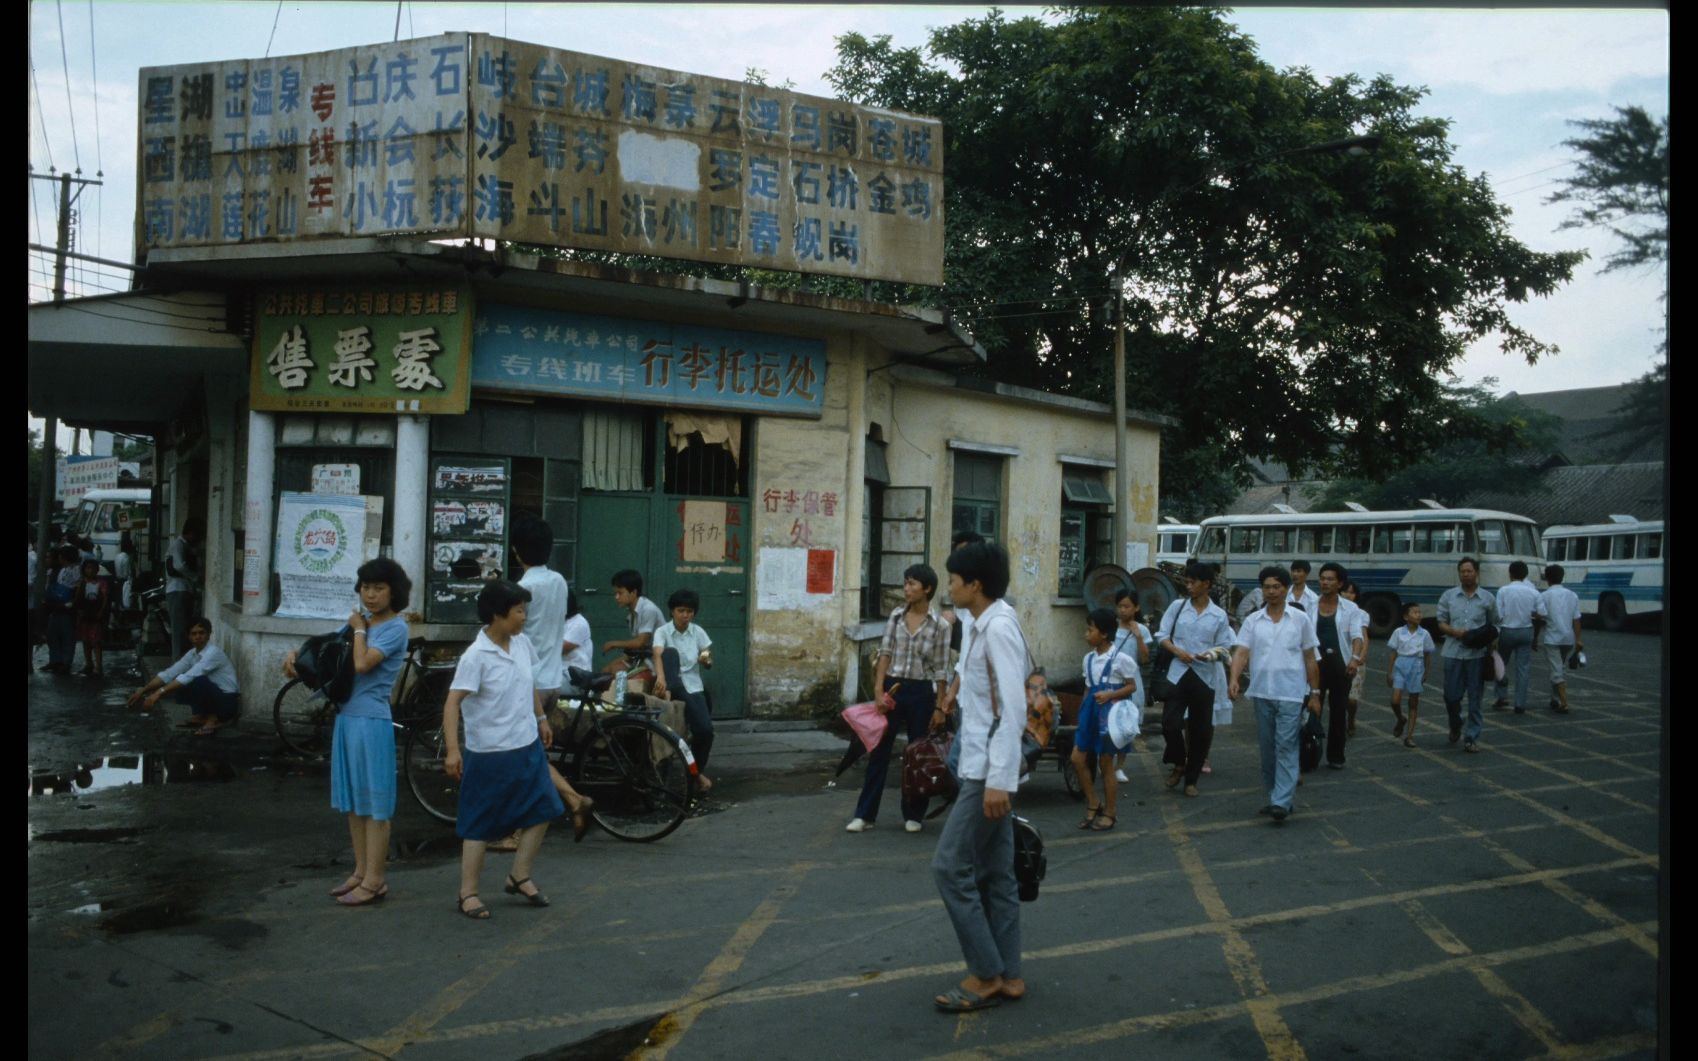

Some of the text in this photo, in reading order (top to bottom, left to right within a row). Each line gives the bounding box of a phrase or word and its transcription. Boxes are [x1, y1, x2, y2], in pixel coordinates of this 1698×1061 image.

[639, 338, 818, 402] 行李托运处
[763, 488, 838, 517] 行李保管
